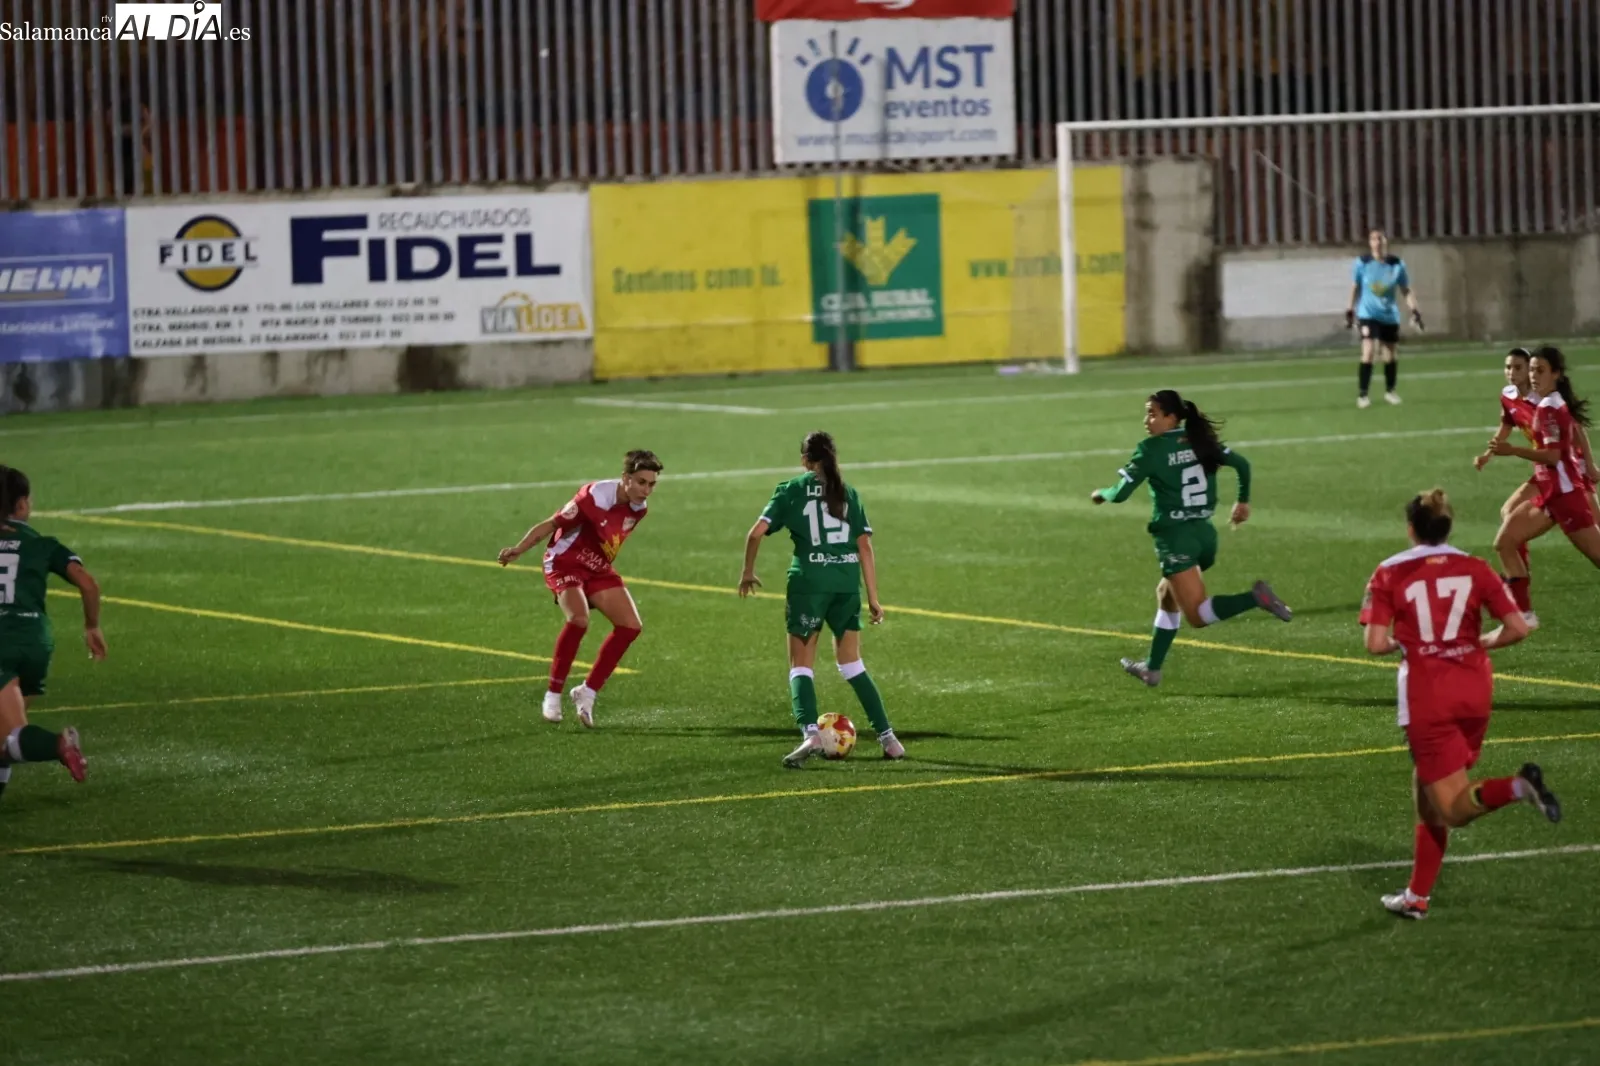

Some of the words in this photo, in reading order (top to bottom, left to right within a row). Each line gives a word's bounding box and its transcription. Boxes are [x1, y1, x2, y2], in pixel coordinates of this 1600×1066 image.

[885, 44, 994, 90] MST
[885, 96, 991, 120] eventos
[377, 208, 531, 231] RECAUCHUTADOS
[159, 241, 258, 265] FIDEL
[290, 214, 561, 285] FIDEL
[1181, 463, 1208, 507] 2
[803, 499, 850, 546] 15
[1405, 575, 1473, 642] 17
